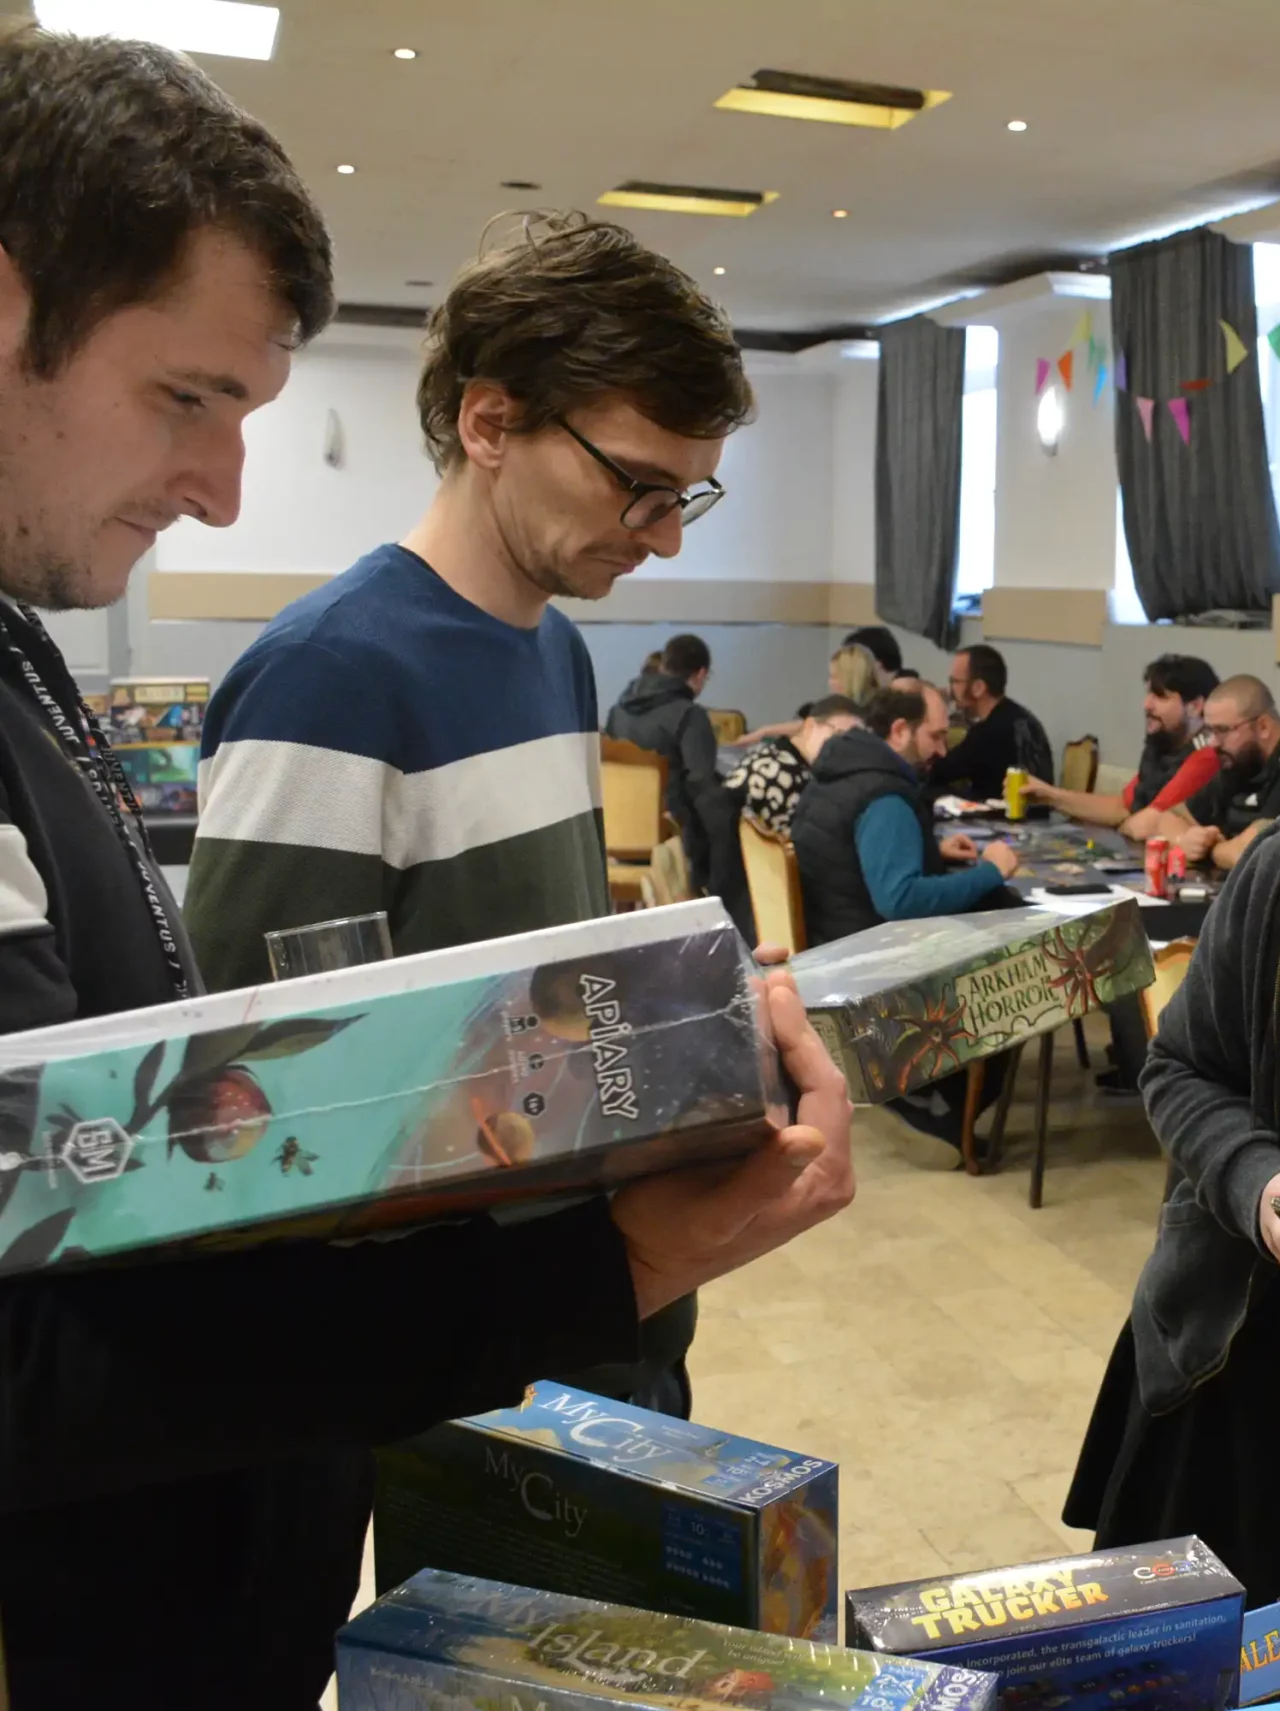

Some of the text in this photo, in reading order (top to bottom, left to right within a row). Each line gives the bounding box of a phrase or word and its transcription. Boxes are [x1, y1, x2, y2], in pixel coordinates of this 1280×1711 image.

[22, 661, 80, 745] JUVENTUS
[137, 860, 177, 954] JUVENTUS
[968, 952, 1048, 1003] ARKHAM
[967, 981, 1061, 1032] HORROR
[579, 973, 640, 1120] APIARY
[538, 1392, 608, 1424] My
[569, 1417, 675, 1463] City
[484, 1445, 526, 1492] My
[520, 1471, 588, 1538] City
[738, 1459, 824, 1504] KOSMOS
[911, 1582, 1110, 1640] TRUCKER
[918, 1568, 1074, 1614] GALAXY
[1006, 1665, 1027, 1678] join
[1028, 1663, 1047, 1672] our
[1049, 1655, 1073, 1668] elite
[1075, 1652, 1102, 1664] team
[1104, 1646, 1117, 1658] of
[1117, 1642, 1151, 1657] galaxy
[1040, 1644, 1058, 1656] the
[1060, 1630, 1127, 1651] transgalactic
[1128, 1625, 1160, 1638] leader
[1162, 1622, 1172, 1633] in
